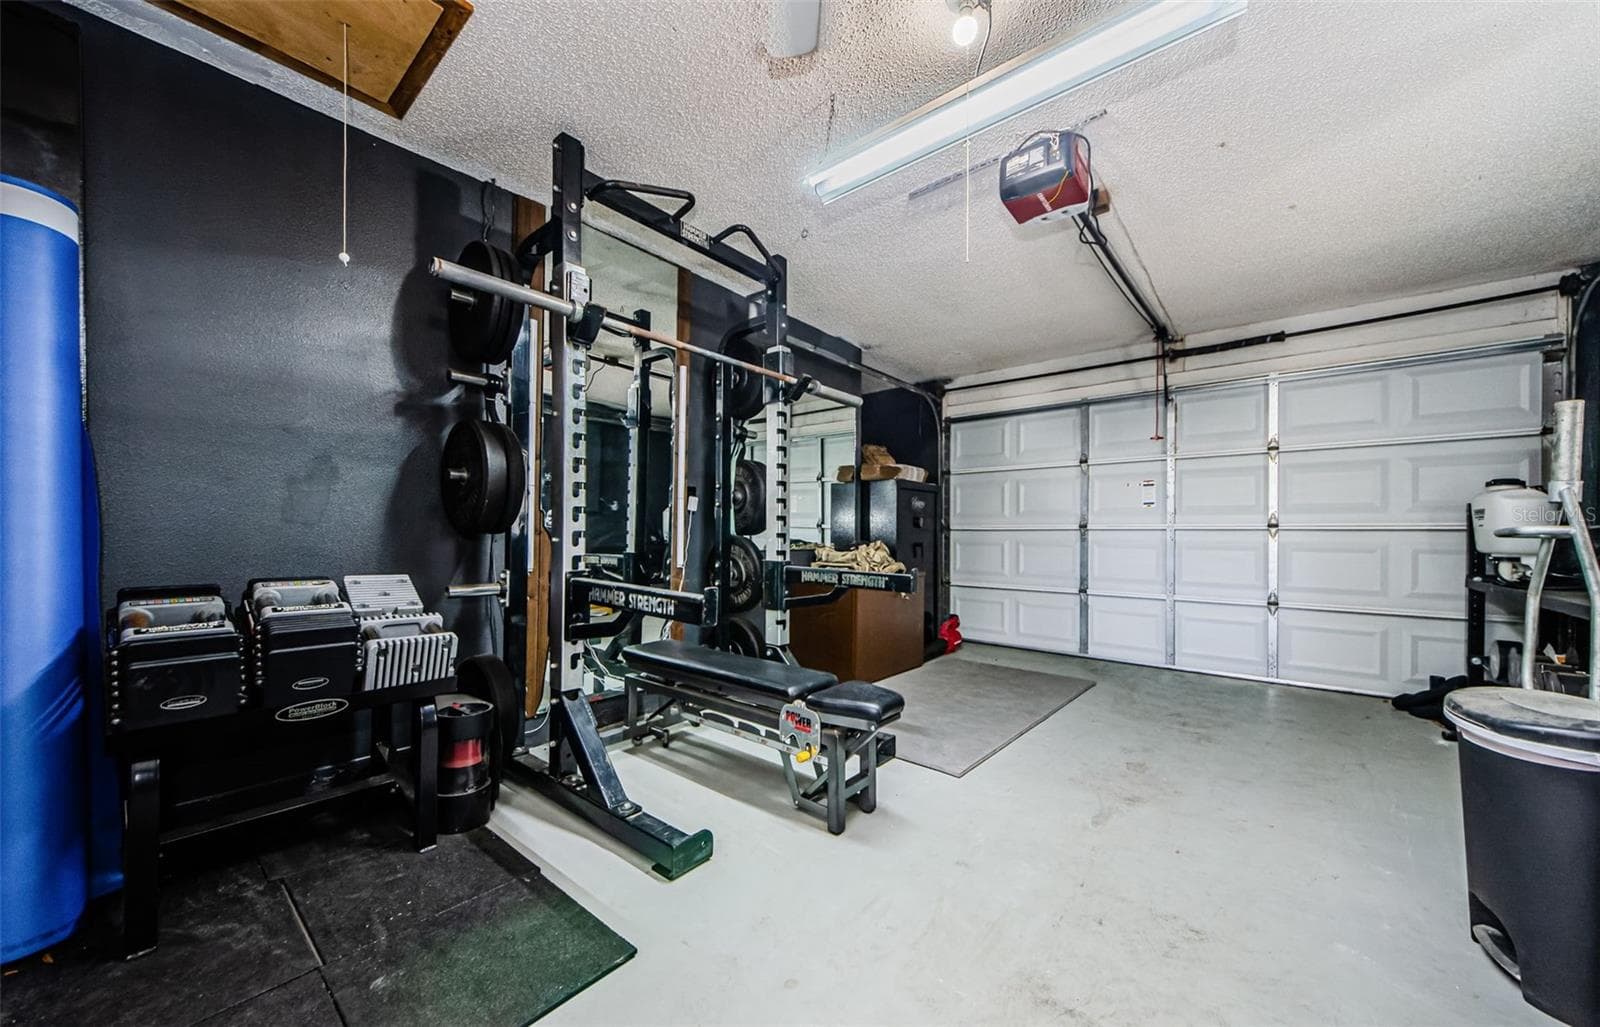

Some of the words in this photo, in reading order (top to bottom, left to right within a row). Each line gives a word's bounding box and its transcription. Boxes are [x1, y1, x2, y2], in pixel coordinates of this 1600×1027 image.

[801, 571, 839, 584] HAMMER
[841, 573, 887, 589] STRENGTH
[588, 586, 626, 608] HAMMER
[628, 592, 675, 616] STRENGTH
[288, 701, 337, 714] PowerBlock
[785, 710, 812, 728] POWER
